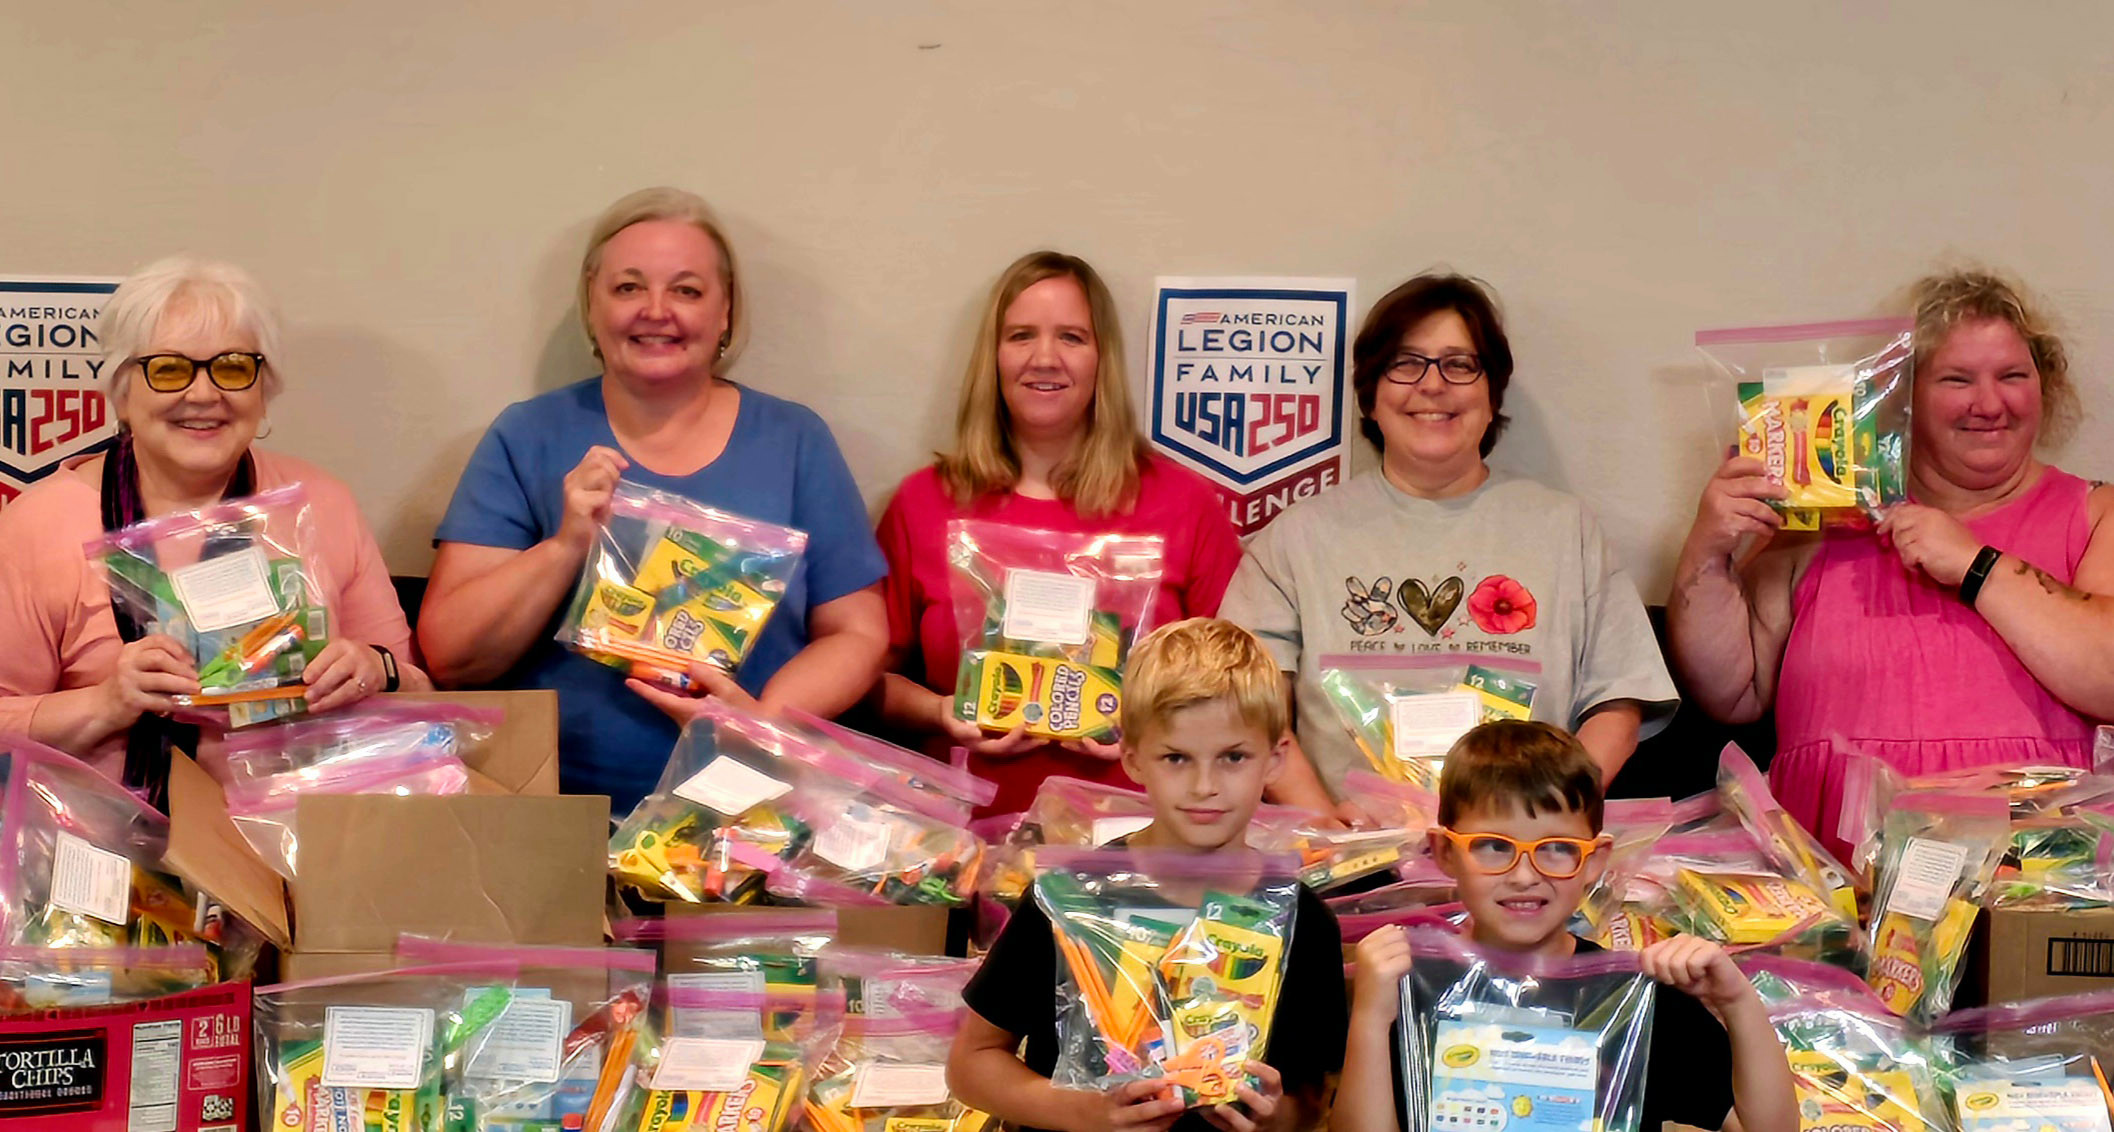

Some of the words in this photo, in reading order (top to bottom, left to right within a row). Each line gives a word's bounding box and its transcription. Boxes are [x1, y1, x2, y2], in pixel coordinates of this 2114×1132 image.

[1220, 313, 1324, 326] AMERICAN
[0, 323, 100, 348] GION
[1178, 329, 1323, 354] LEGION
[8, 359, 105, 379] MILY
[1176, 363, 1322, 384] FAMILY
[3, 388, 105, 456] A250
[1832, 407, 1849, 476] Crayola
[1217, 467, 1334, 527] LENGE
[679, 557, 743, 600] Crola
[1350, 640, 1386, 651] PEACE
[1411, 642, 1441, 655] LOVE
[1466, 640, 1532, 655] REMEMBER
[987, 665, 1004, 715] Crayola
[1471, 674, 1485, 689] 12
[1049, 664, 1070, 732] COLORED
[1062, 670, 1087, 730] PENCILS
[1099, 697, 1115, 712] 12
[962, 701, 977, 717] 12
[1206, 902, 1222, 921] 12
[199, 1020, 208, 1037] 2
[215, 1013, 224, 1034] 6
[1184, 1012, 1239, 1025] Craya
[11, 1066, 74, 1089] CHIPS
[283, 1108, 301, 1126] 10
[447, 1104, 465, 1122] 12
[649, 1090, 672, 1132] rayol
